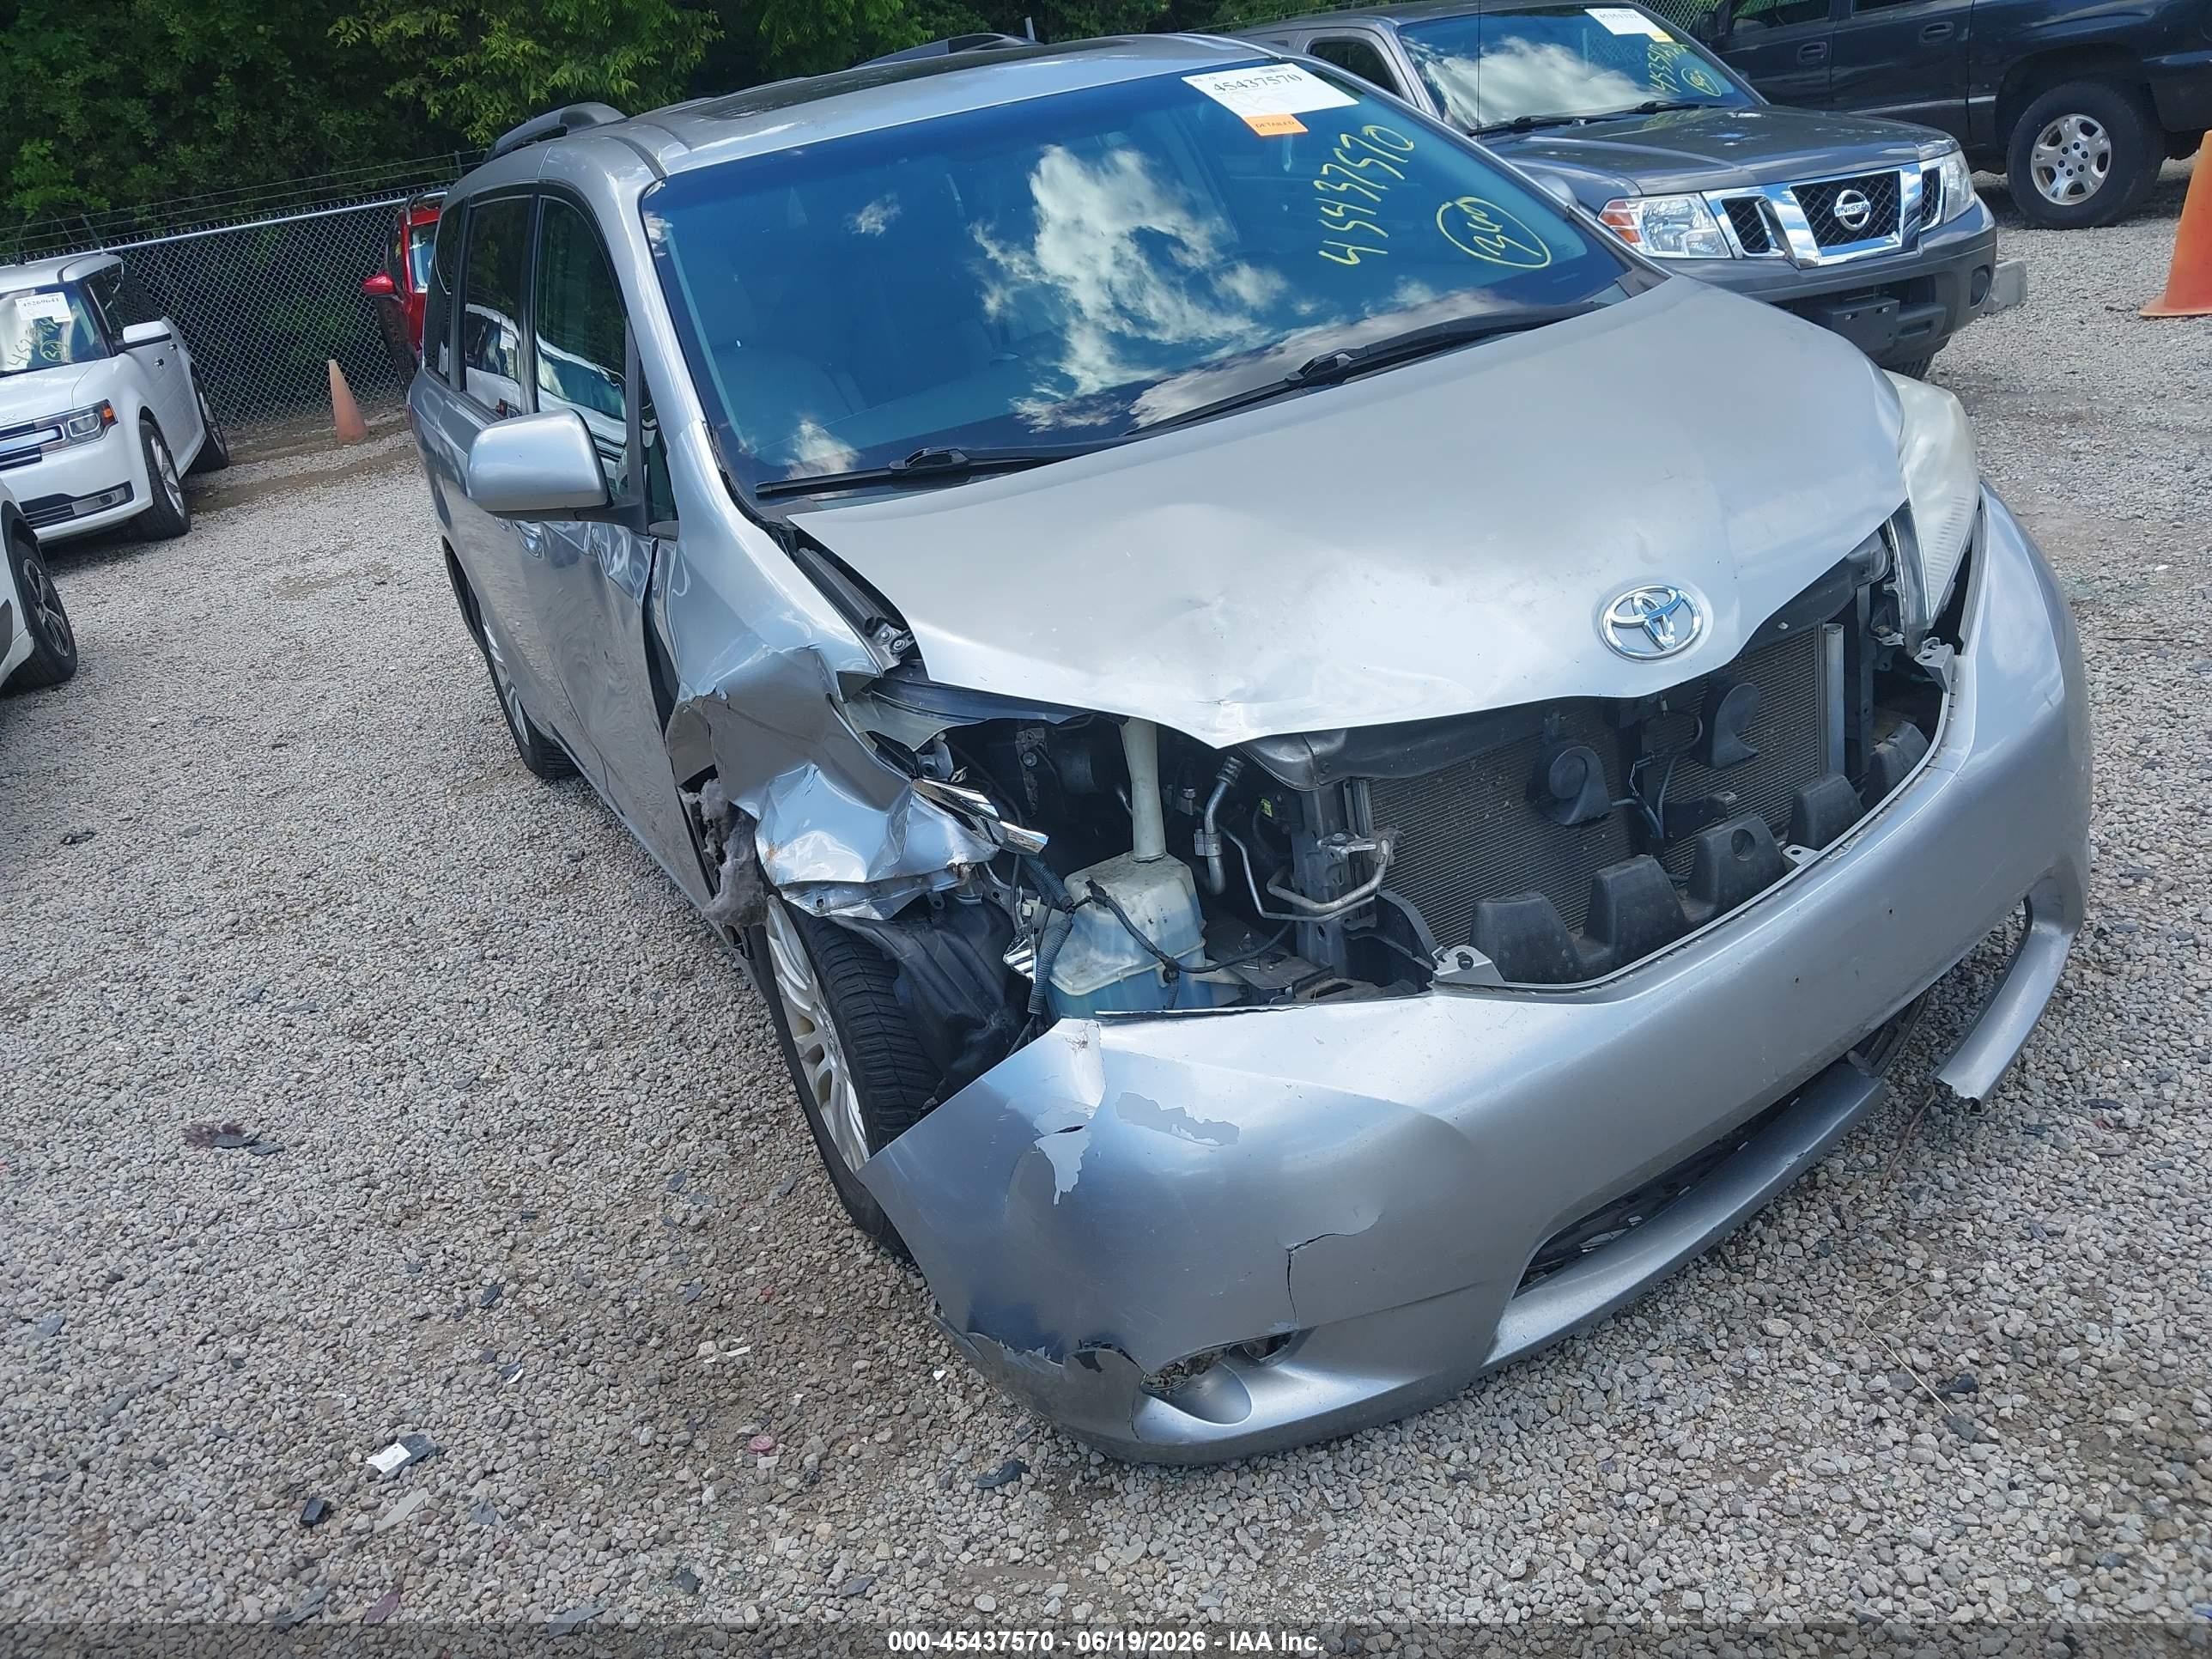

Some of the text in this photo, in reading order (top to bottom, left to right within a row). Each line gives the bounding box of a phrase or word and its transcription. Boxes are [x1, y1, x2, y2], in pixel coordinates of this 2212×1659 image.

[1213, 74, 1304, 93] 45437570
[1312, 124, 1415, 265] 45437570
[1841, 204, 1869, 214] NISSAN
